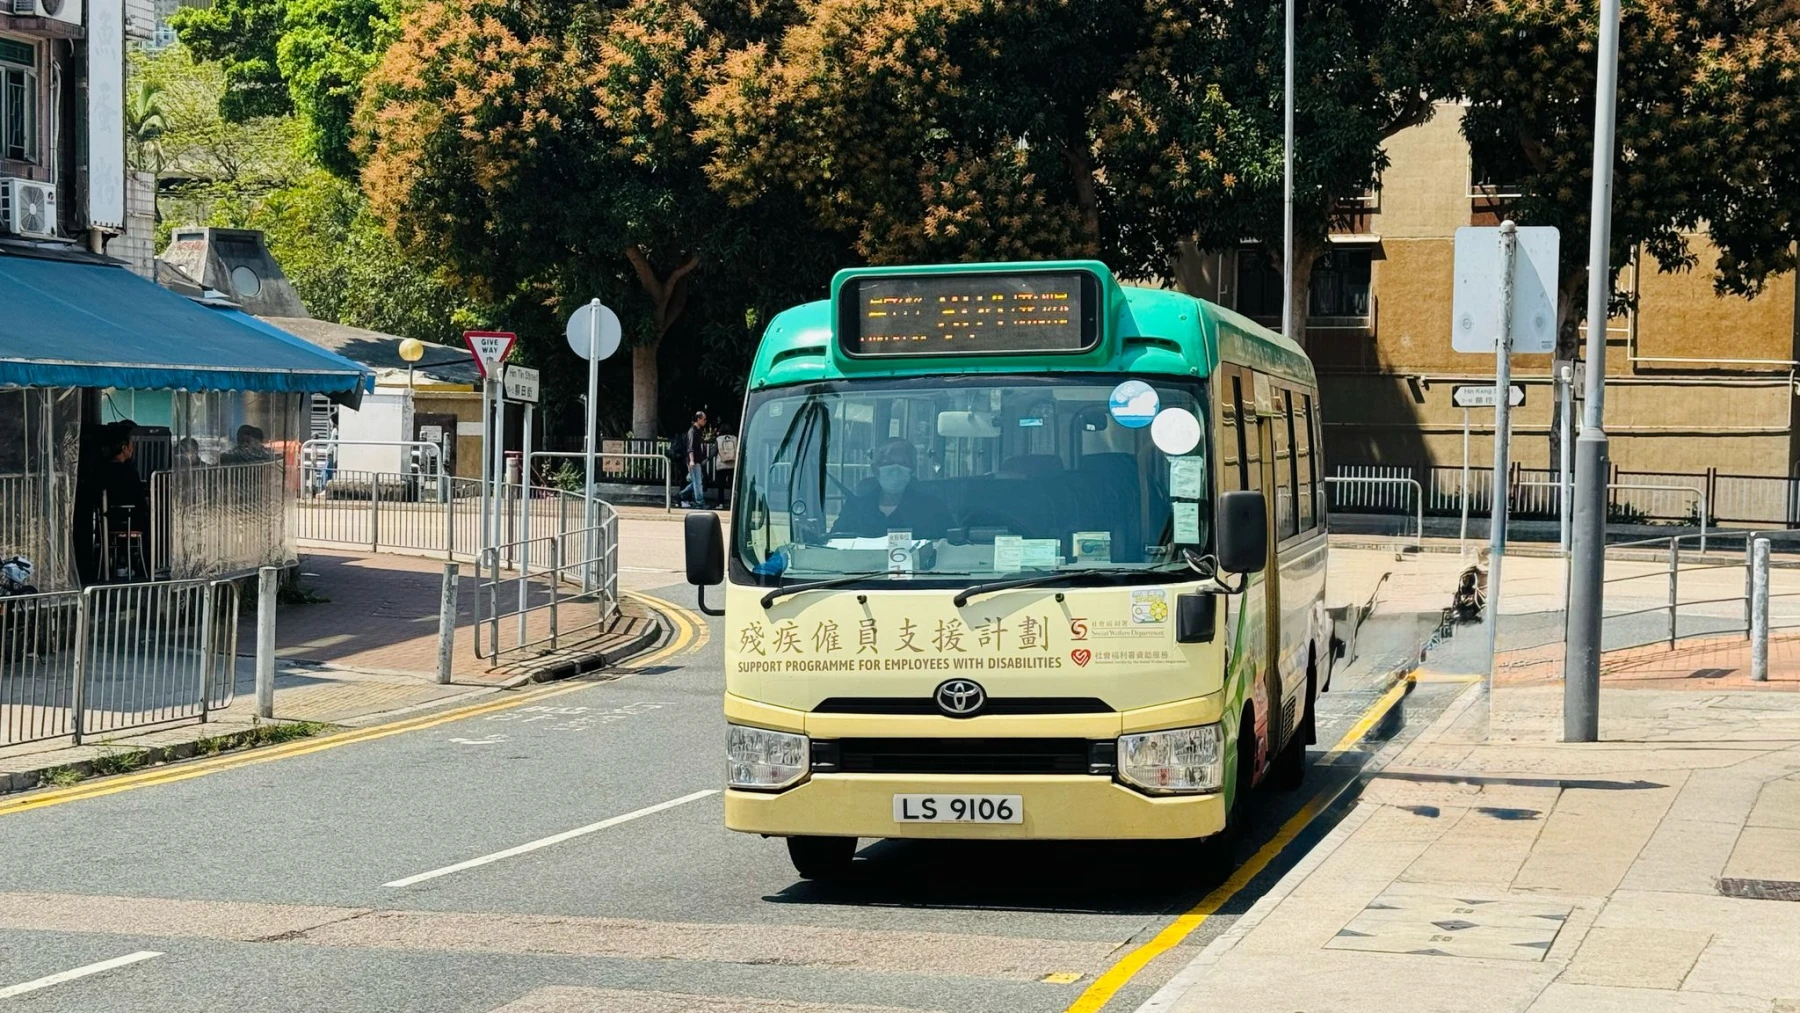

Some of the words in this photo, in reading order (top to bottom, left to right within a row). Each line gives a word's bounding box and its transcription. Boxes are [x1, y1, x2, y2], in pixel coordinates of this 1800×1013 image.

[890, 547, 907, 563] 6
[738, 615, 1049, 656] 殘疾僱員支援計劃
[1131, 629, 1165, 638] Department
[738, 660, 783, 673] SUPPORT
[785, 659, 855, 672] PROGRAMME
[858, 659, 881, 671] FOR
[884, 658, 950, 671] EMPLOYEES
[953, 657, 984, 670] WITH
[987, 656, 1062, 669] DISABILITIES
[902, 797, 938, 820] LS
[950, 797, 1014, 821] 9106
